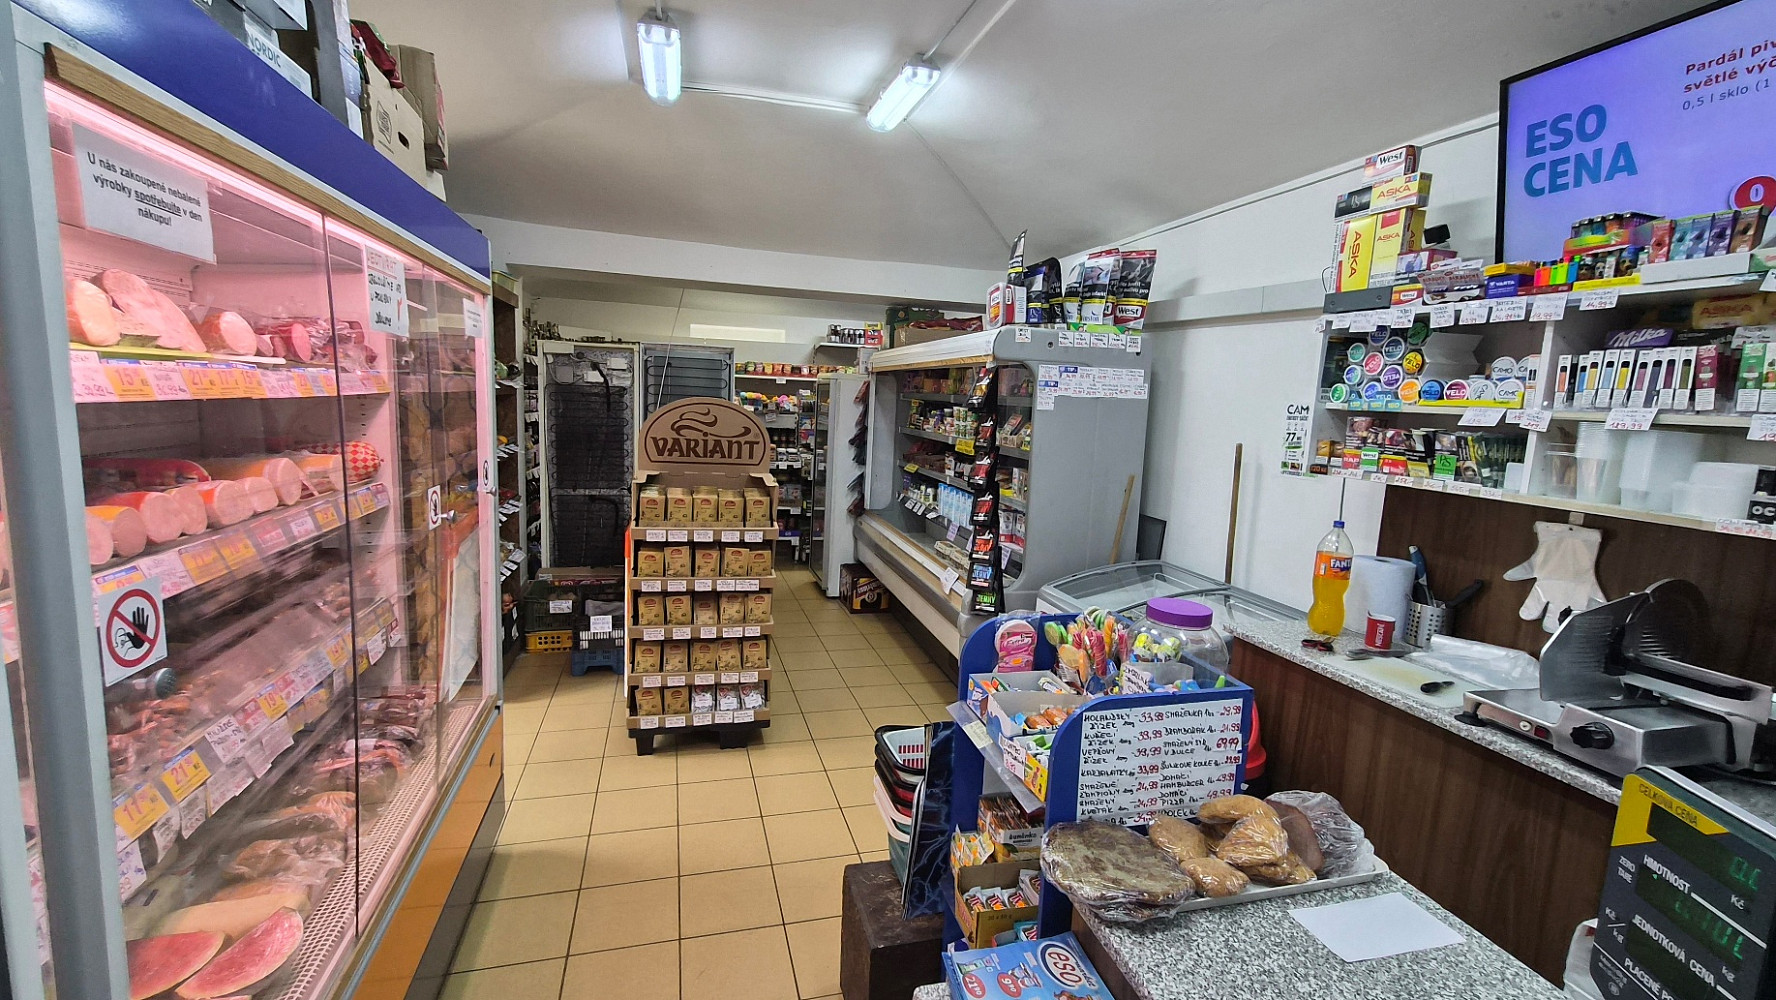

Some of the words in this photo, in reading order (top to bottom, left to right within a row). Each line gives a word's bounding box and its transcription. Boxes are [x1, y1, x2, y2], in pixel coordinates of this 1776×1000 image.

[248, 33, 281, 67] NORDIC
[1686, 47, 1744, 75] Pardál
[1684, 68, 1738, 93] světlé
[1682, 96, 1704, 111] 0,5
[1719, 86, 1748, 101] sklo
[1526, 104, 1608, 158] ESO
[1379, 151, 1403, 166] West
[1524, 141, 1638, 198] CENA
[87, 151, 96, 164] U
[99, 158, 118, 174] nás
[119, 166, 167, 194] zakoupené
[168, 186, 201, 207] nebalené
[92, 173, 132, 199] výrobky
[134, 189, 182, 216] spotřebujte
[189, 209, 203, 222] den
[1376, 184, 1412, 200] ASKA
[138, 207, 173, 227] nákupu!
[1376, 231, 1401, 243] ASKA
[1348, 230, 1362, 279] ASKA
[1496, 279, 1515, 287] VARTA
[1116, 306, 1140, 318] West
[1700, 303, 1754, 317] ASKA
[1608, 329, 1667, 348] Milka
[1405, 357, 1420, 370] VELO
[1518, 365, 1528, 374] CA
[1287, 404, 1309, 415] CAM
[650, 431, 761, 460] VARIANT
[1675, 806, 1699, 828] CENA
[1619, 855, 1635, 873] ZERO
[1643, 854, 1691, 894] HMOTNOST
[1730, 894, 1745, 910] Kč
[1631, 914, 1686, 963] JEDNOTKOVÁ
[1689, 958, 1716, 987] CENA
[1048, 951, 1083, 984] eso
[1624, 957, 1661, 996] PLACENÉ
